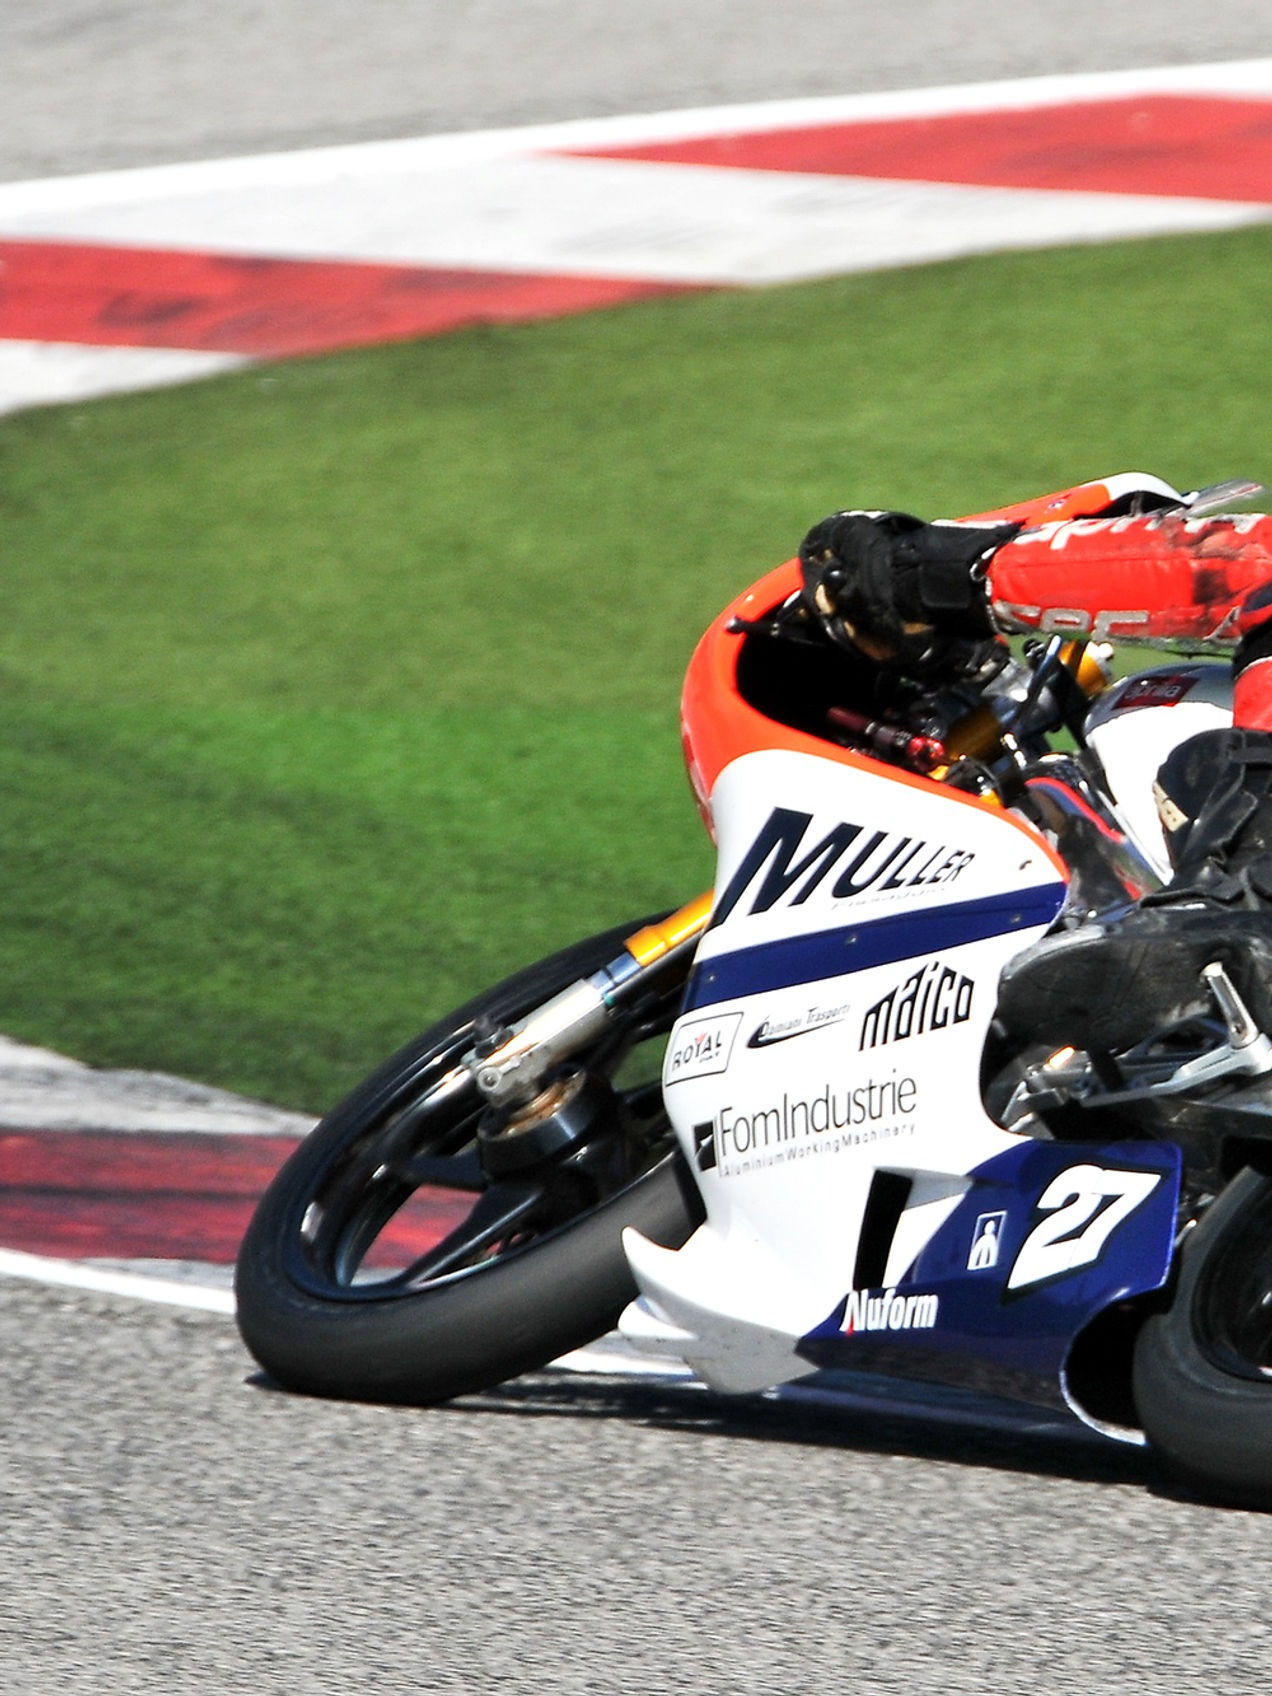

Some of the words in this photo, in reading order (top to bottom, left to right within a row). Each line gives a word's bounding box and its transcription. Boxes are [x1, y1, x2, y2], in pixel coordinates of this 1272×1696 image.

[701, 806, 976, 938] MULLER
[671, 1029, 723, 1072] ROYAL
[720, 1068, 918, 1158] FomIndustrie
[1006, 1162, 1162, 1290] 27
